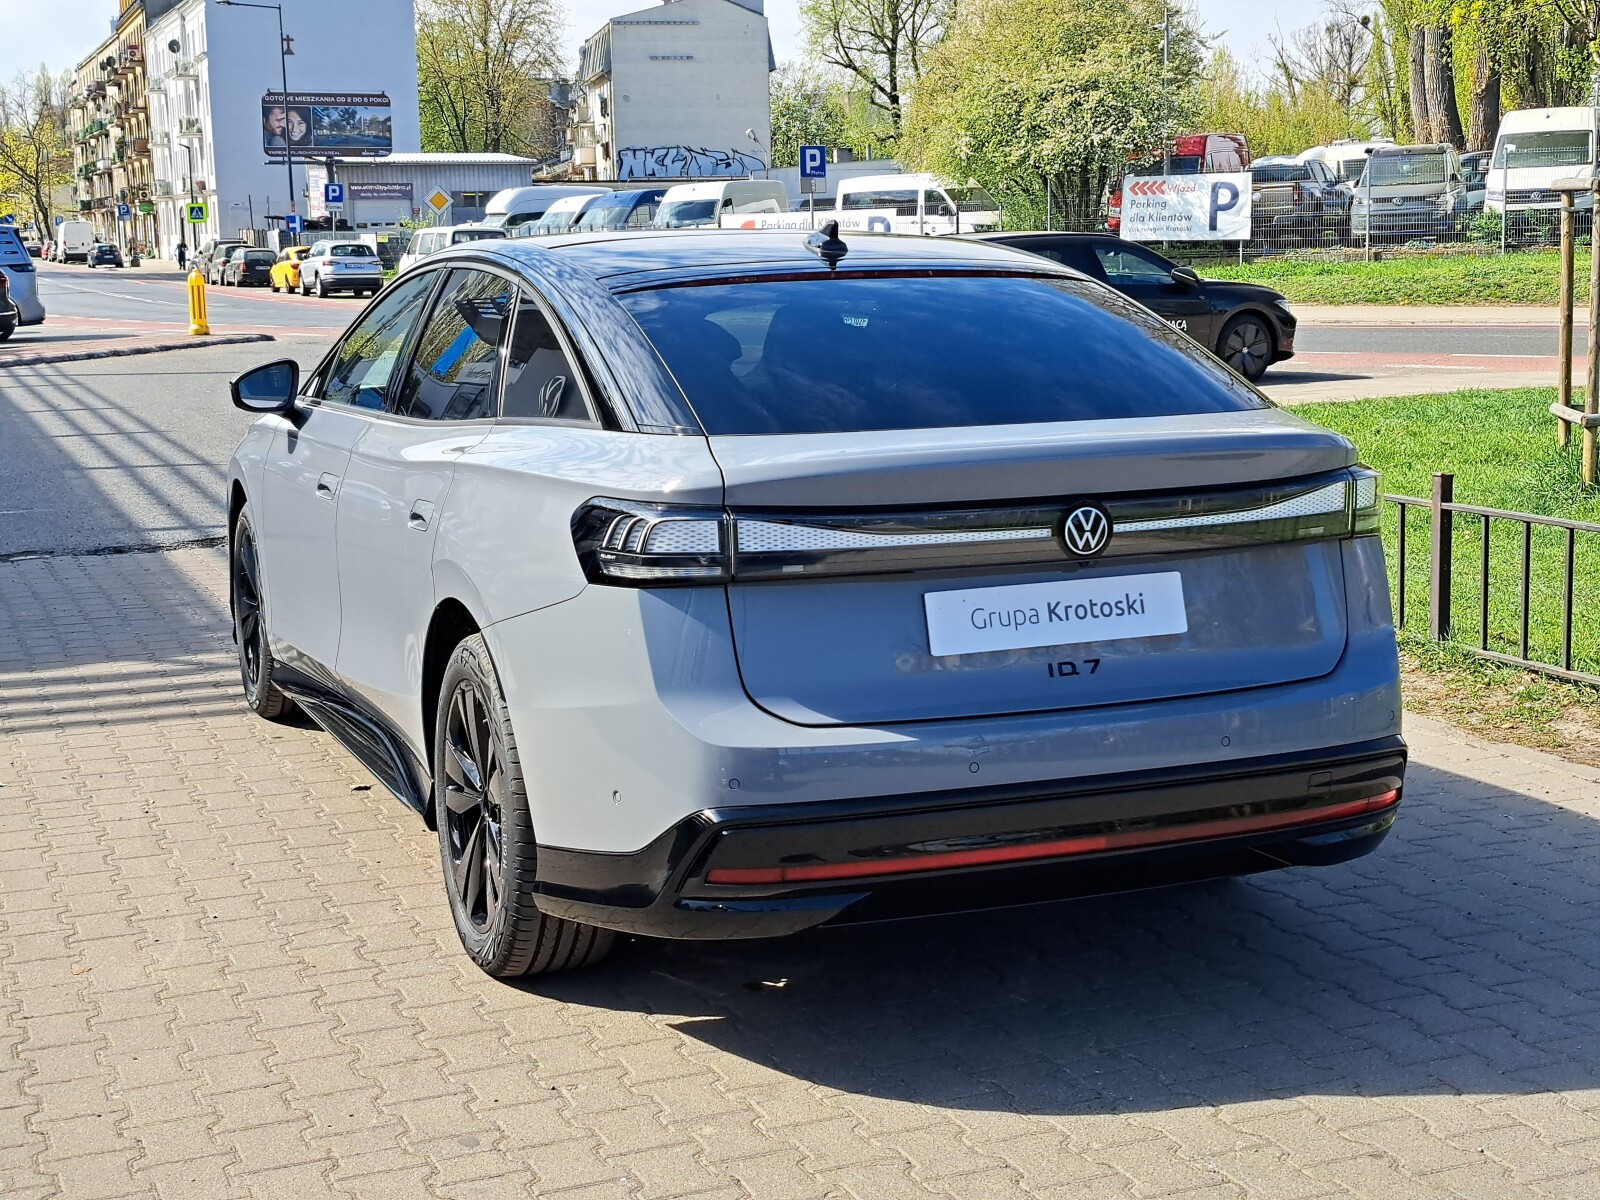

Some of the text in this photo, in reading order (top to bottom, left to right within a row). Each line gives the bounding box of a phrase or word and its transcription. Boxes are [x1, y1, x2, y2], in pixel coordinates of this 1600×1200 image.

[805, 148, 821, 174] P
[329, 185, 340, 201] P
[1168, 183, 1196, 194] Wjazd
[1130, 199, 1167, 210] Parking
[1209, 181, 1240, 231] P
[1129, 210, 1193, 223] dla Klientów
[970, 593, 1146, 631] Grupa Krotoski
